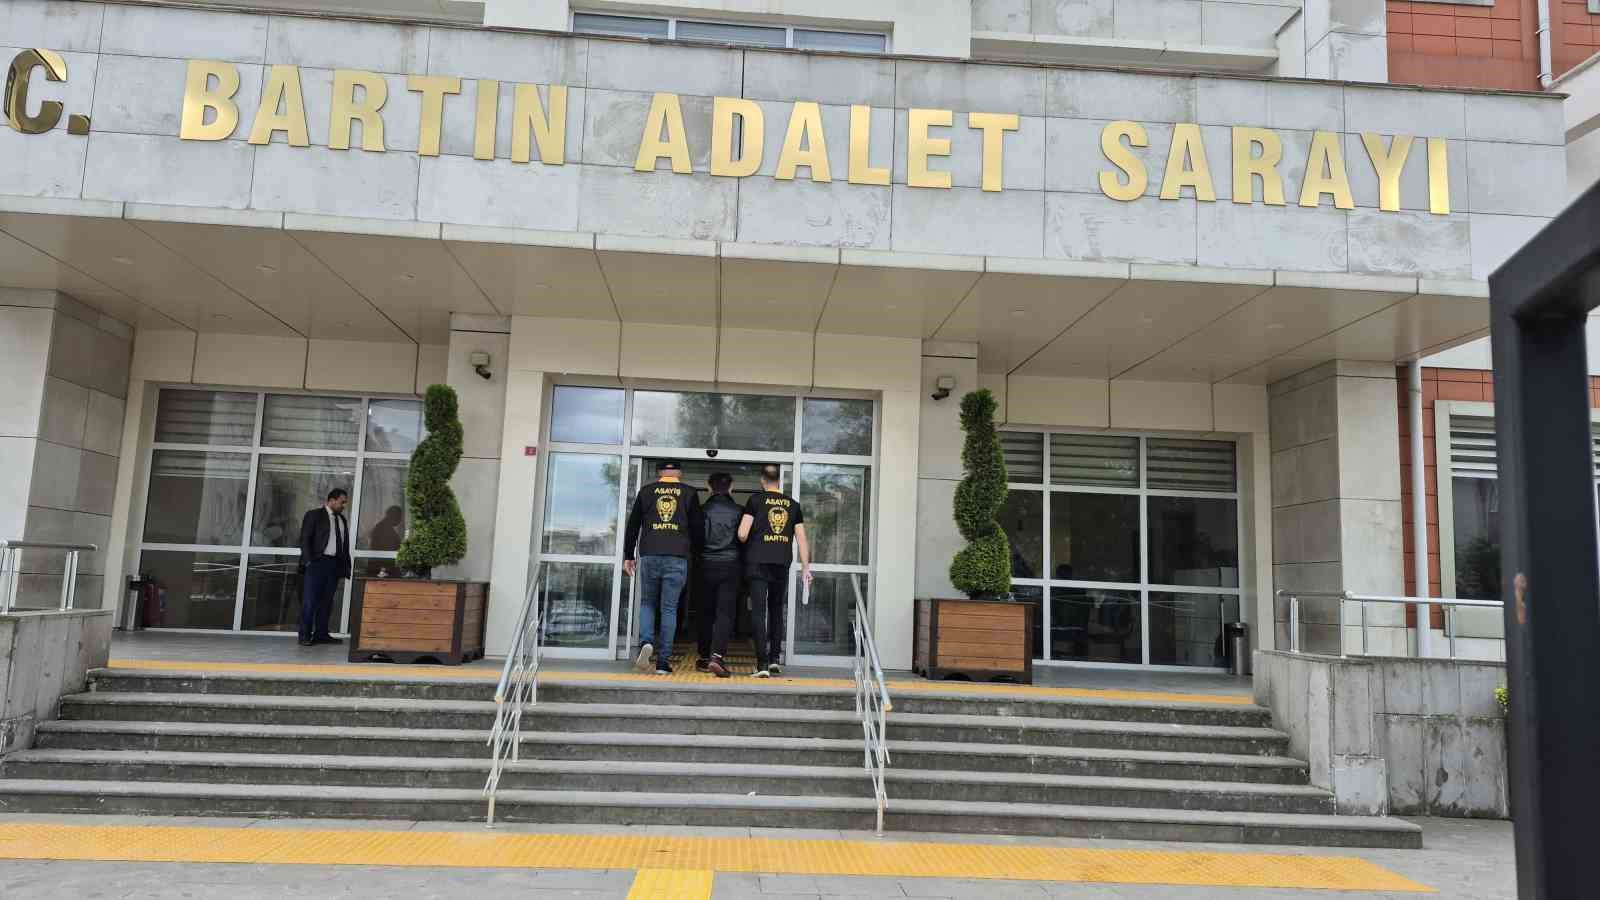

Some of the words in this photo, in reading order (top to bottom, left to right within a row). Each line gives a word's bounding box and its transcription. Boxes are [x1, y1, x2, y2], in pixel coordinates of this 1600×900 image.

[4, 48, 90, 134] C.
[180, 59, 568, 165] BARTIN
[634, 93, 1020, 193] ADALET
[1099, 119, 1451, 216] SARAYI
